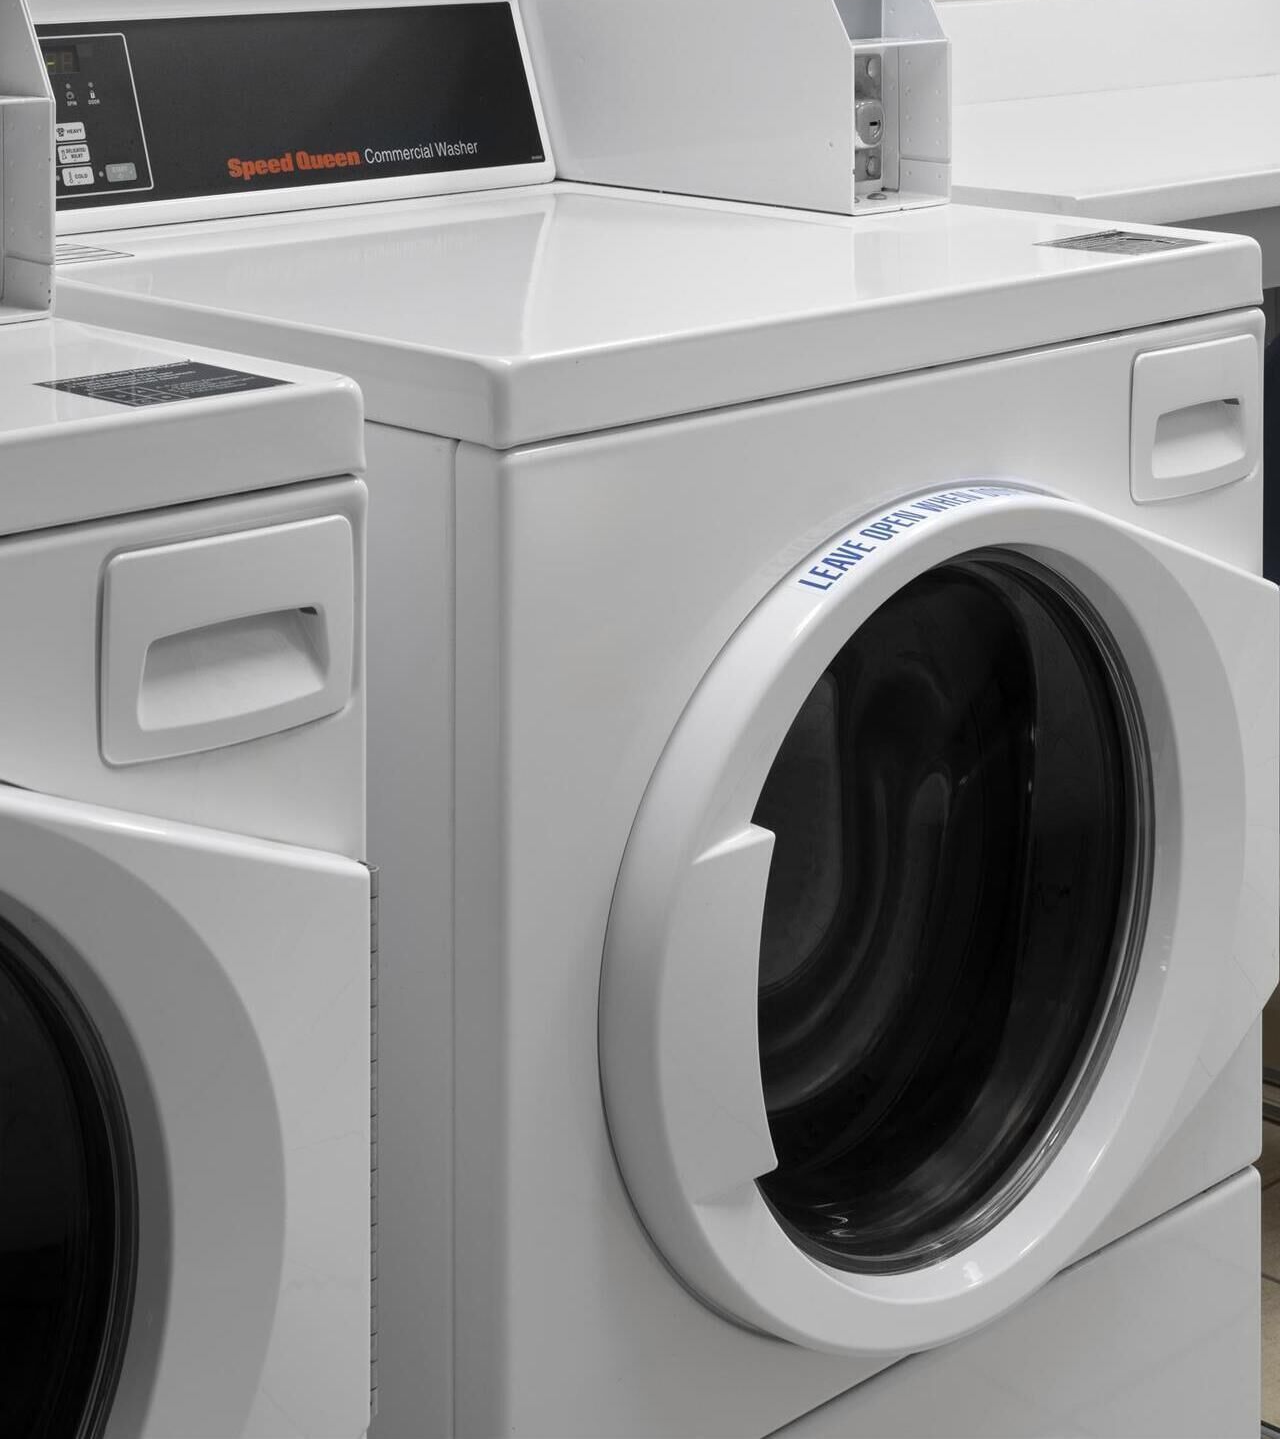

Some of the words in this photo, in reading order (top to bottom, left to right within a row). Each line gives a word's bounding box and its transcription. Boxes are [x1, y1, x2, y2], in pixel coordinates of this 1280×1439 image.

[227, 154, 294, 181] Speed
[296, 149, 361, 170] Queen
[364, 142, 433, 165] Commercial
[434, 139, 479, 158] Washer
[797, 539, 877, 591] LEAVE
[859, 509, 927, 541] OPEN
[910, 491, 985, 513] WHEN
